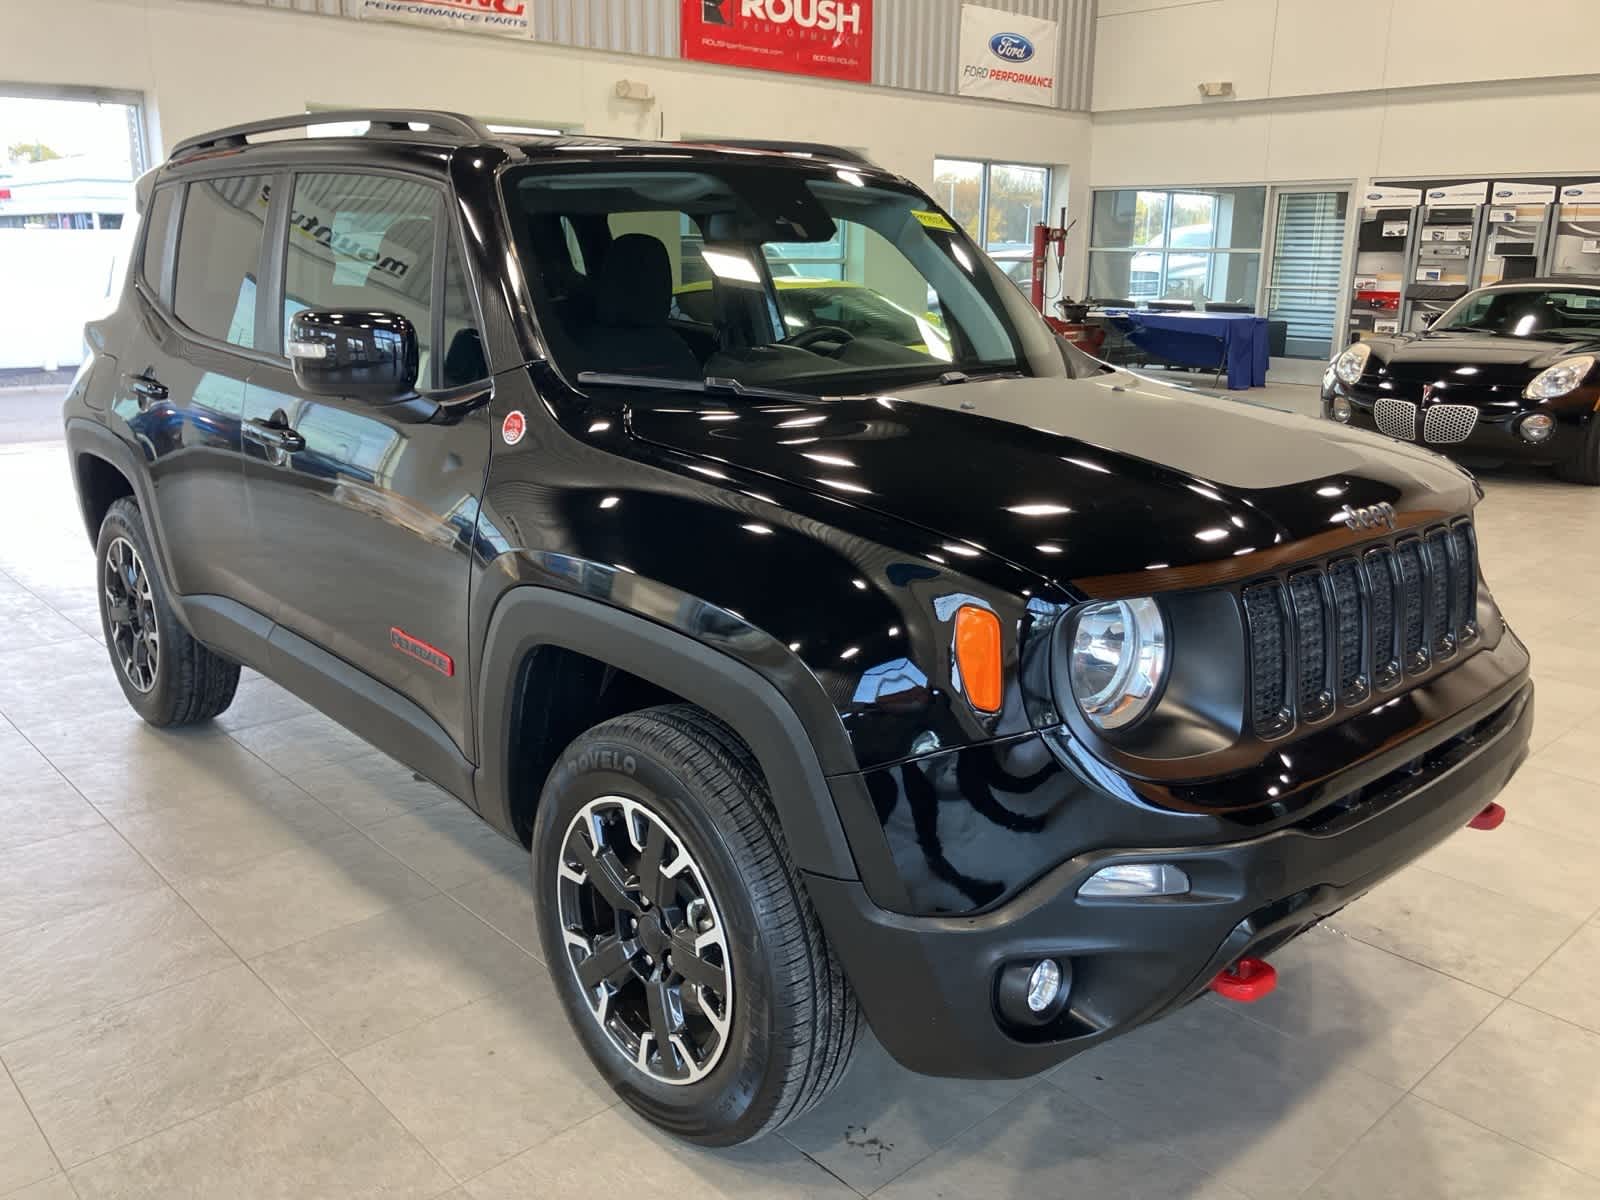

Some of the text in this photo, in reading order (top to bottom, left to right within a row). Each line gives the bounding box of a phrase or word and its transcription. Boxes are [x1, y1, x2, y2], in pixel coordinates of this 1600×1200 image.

[364, 1, 480, 22] PERFORMANCE
[484, 16, 528, 27] PARTS
[741, 0, 861, 34] ROUSH
[997, 36, 1026, 58] Ford
[963, 65, 1053, 88] FORD PERFORMANCE
